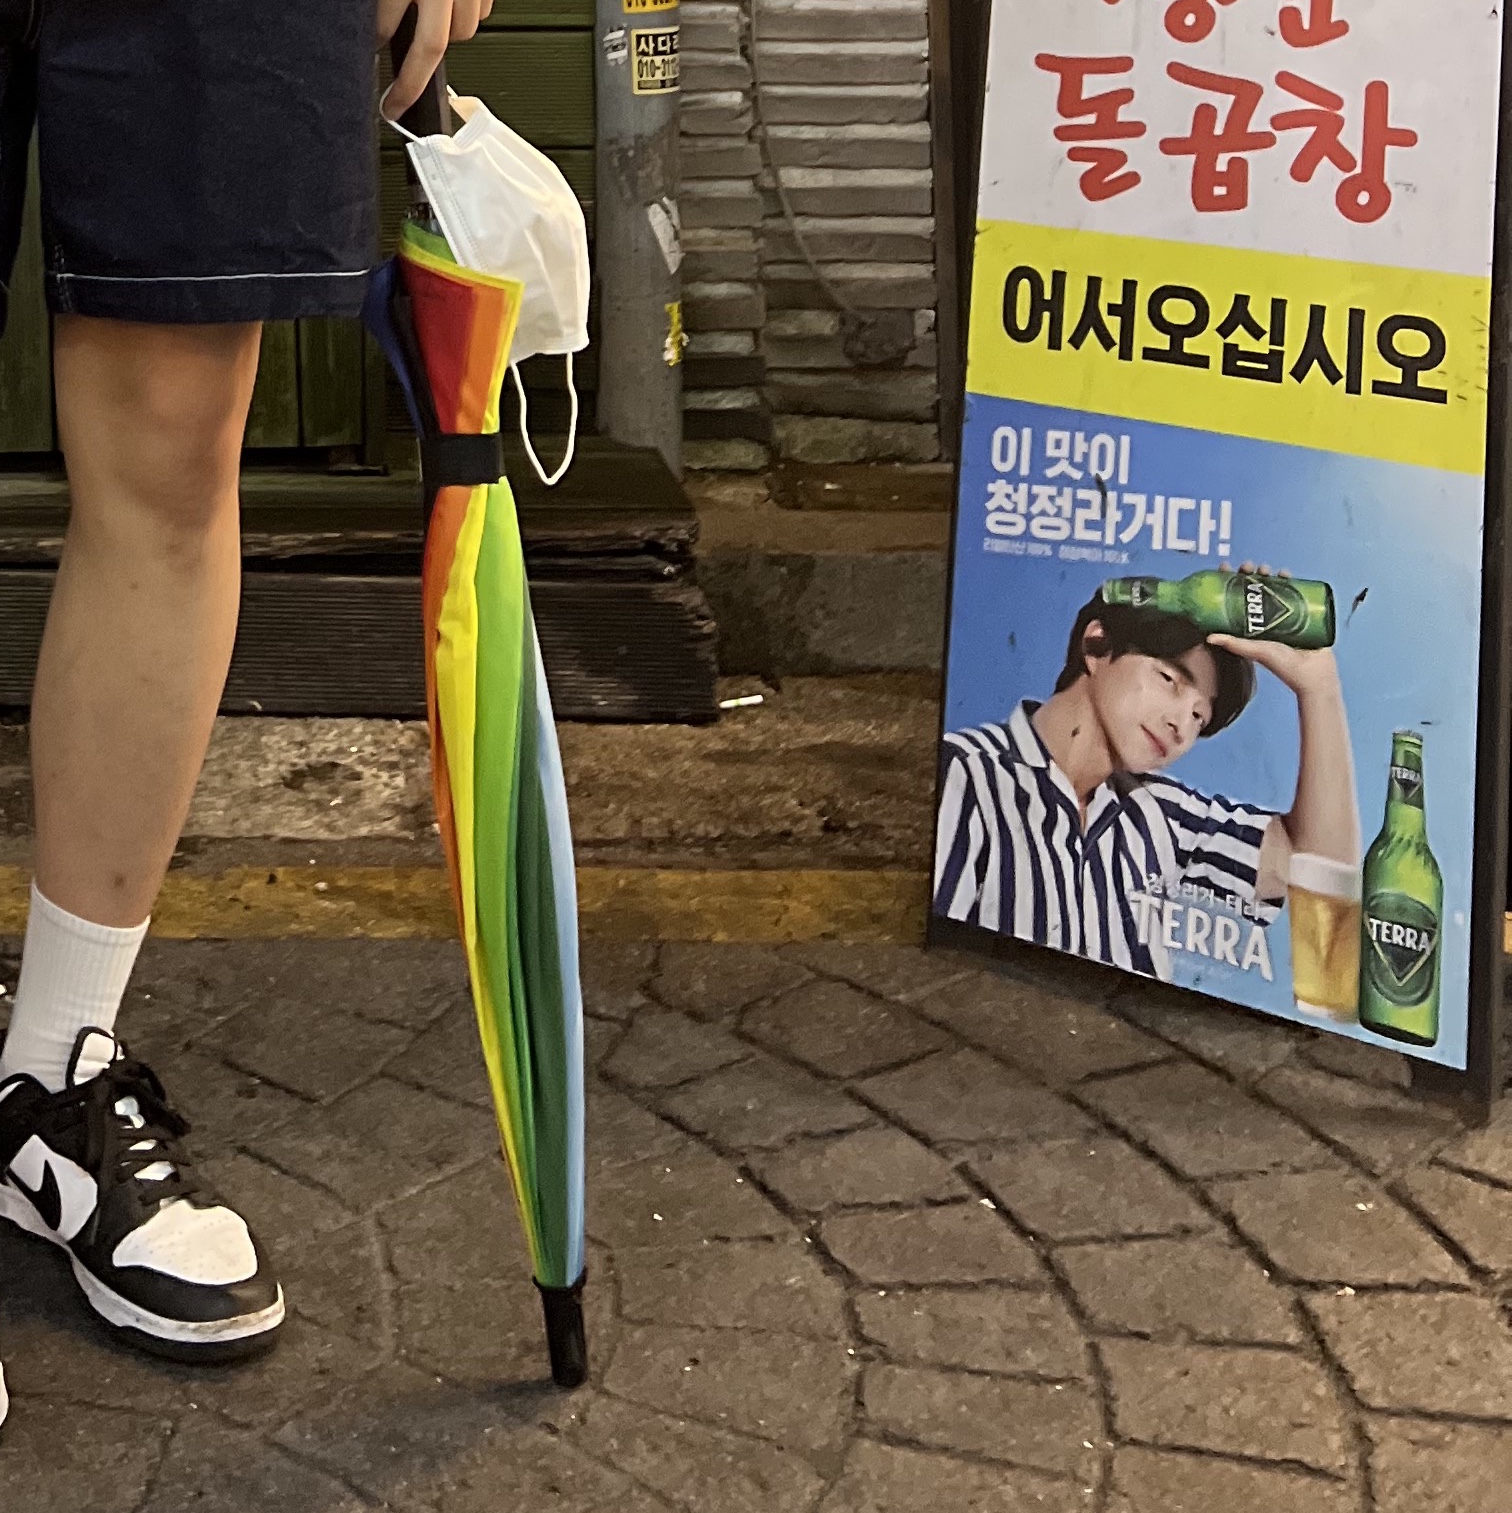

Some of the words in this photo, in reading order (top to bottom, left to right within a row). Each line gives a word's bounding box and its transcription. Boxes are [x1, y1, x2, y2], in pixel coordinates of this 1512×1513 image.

[1000, 264, 1450, 406] 어서오십시오
[991, 426, 1032, 477] 이
[1045, 429, 1131, 485] 맛이
[985, 478, 1232, 557] 청정라거다!
[1246, 582, 1265, 634] TERRA
[1130, 890, 1274, 982] TERRA
[1368, 916, 1431, 957] TERRA
